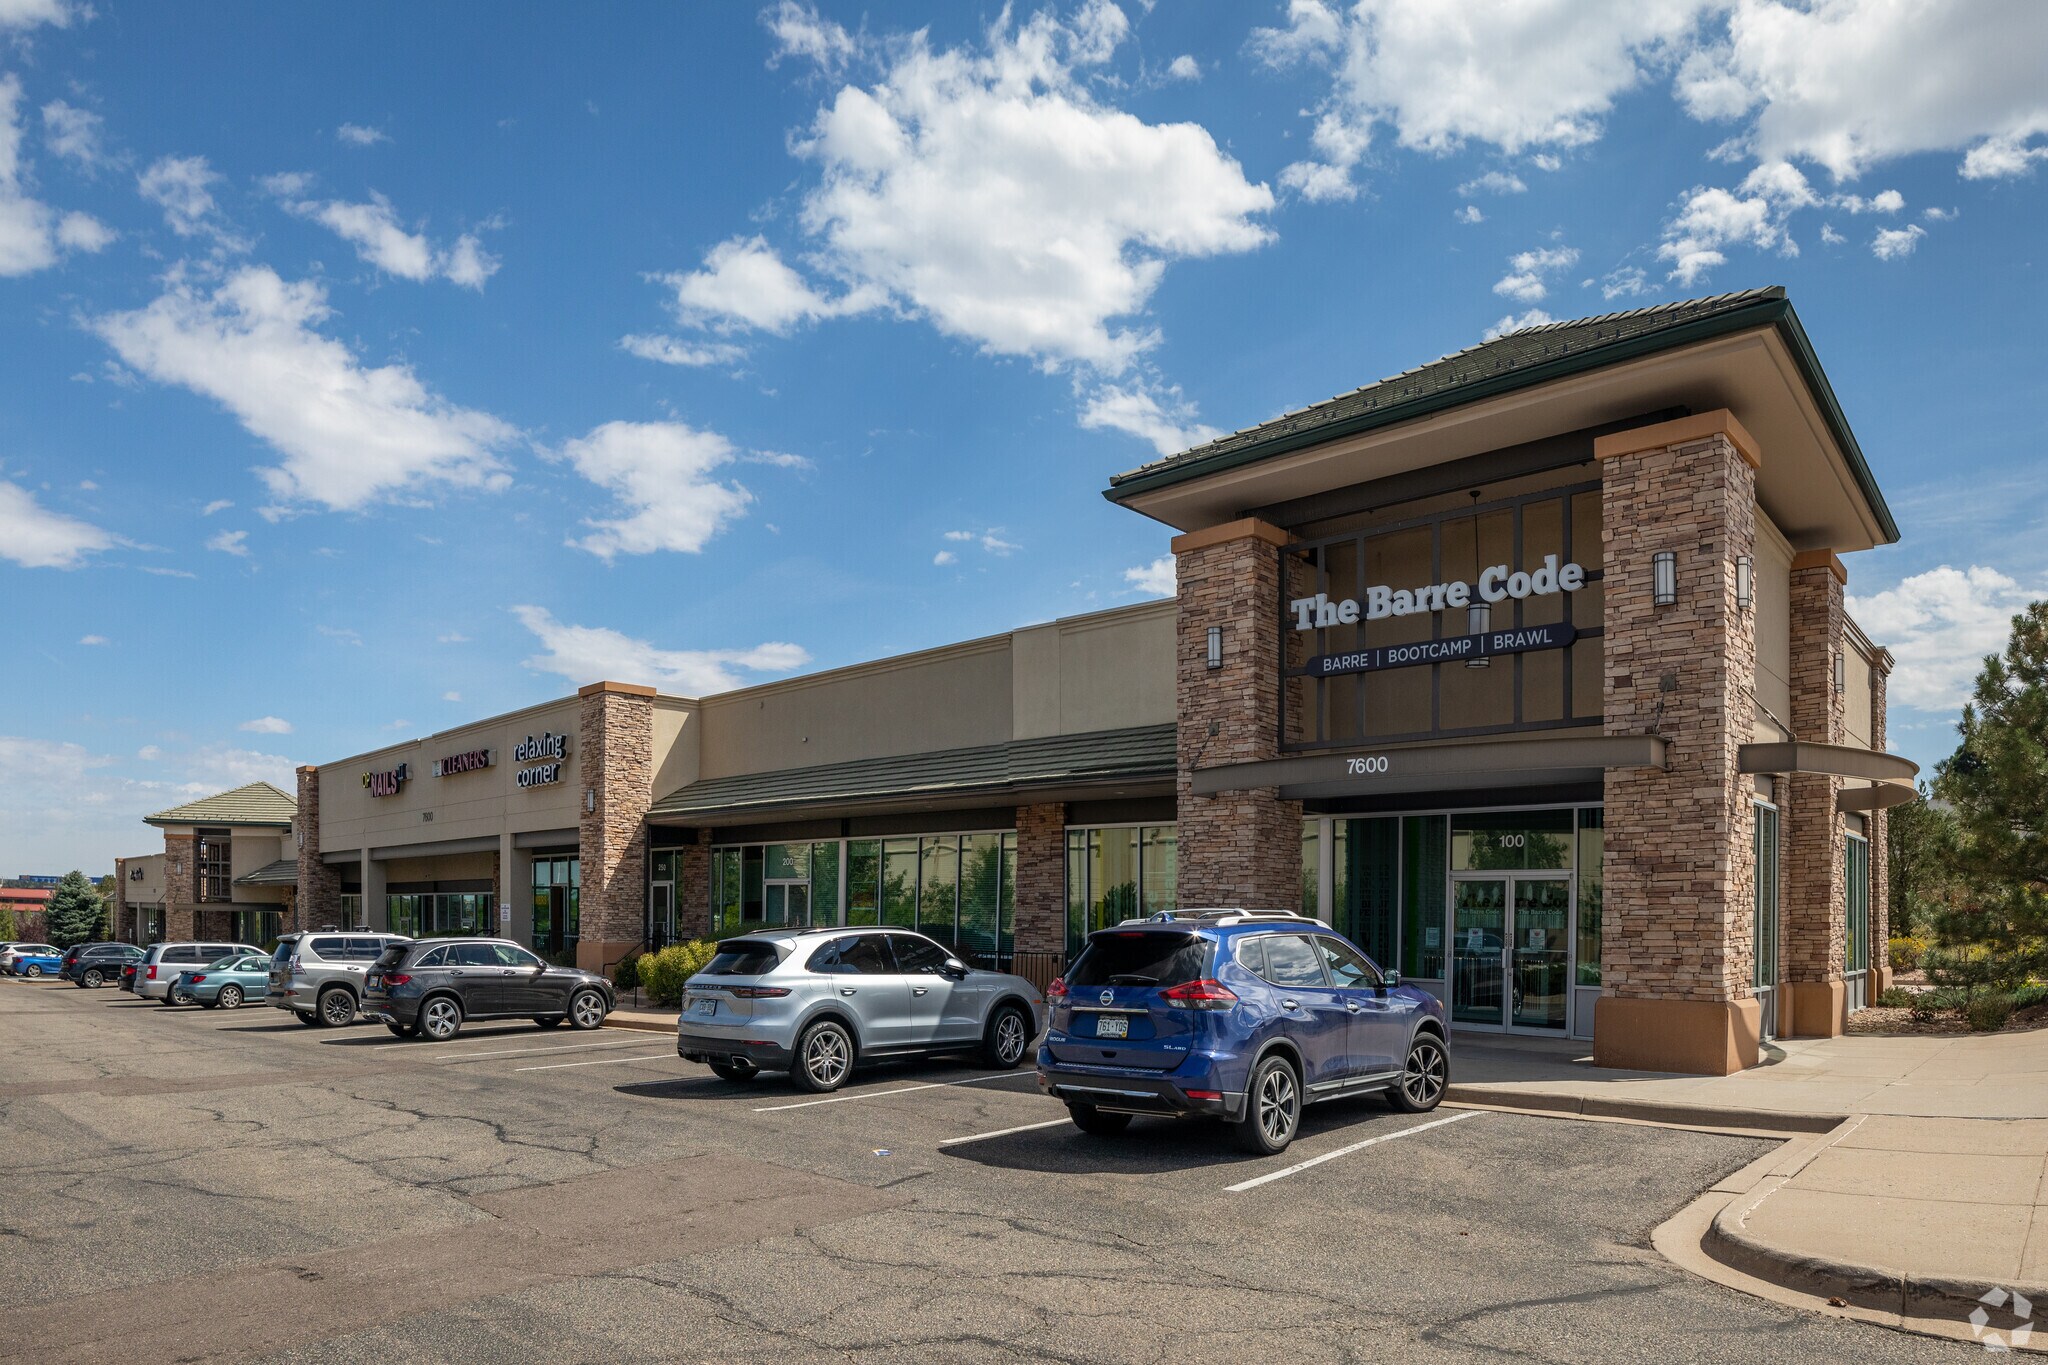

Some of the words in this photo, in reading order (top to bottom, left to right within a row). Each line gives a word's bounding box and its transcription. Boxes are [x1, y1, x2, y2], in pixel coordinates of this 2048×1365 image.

[1290, 593, 1360, 631] The
[1366, 580, 1471, 620] Barre
[1478, 553, 1586, 604] Code
[1322, 653, 1369, 673] BARRE
[1388, 638, 1472, 664] BOOTCAMP
[1493, 628, 1553, 650] BRAWL
[513, 732, 566, 761] relaxing
[441, 749, 487, 777] CLEANERS
[516, 763, 560, 788] corner
[1346, 756, 1389, 774] 7600
[370, 769, 399, 798] NAILS
[1498, 834, 1525, 848] 100
[658, 863, 667, 871] 250
[782, 858, 794, 866] 200
